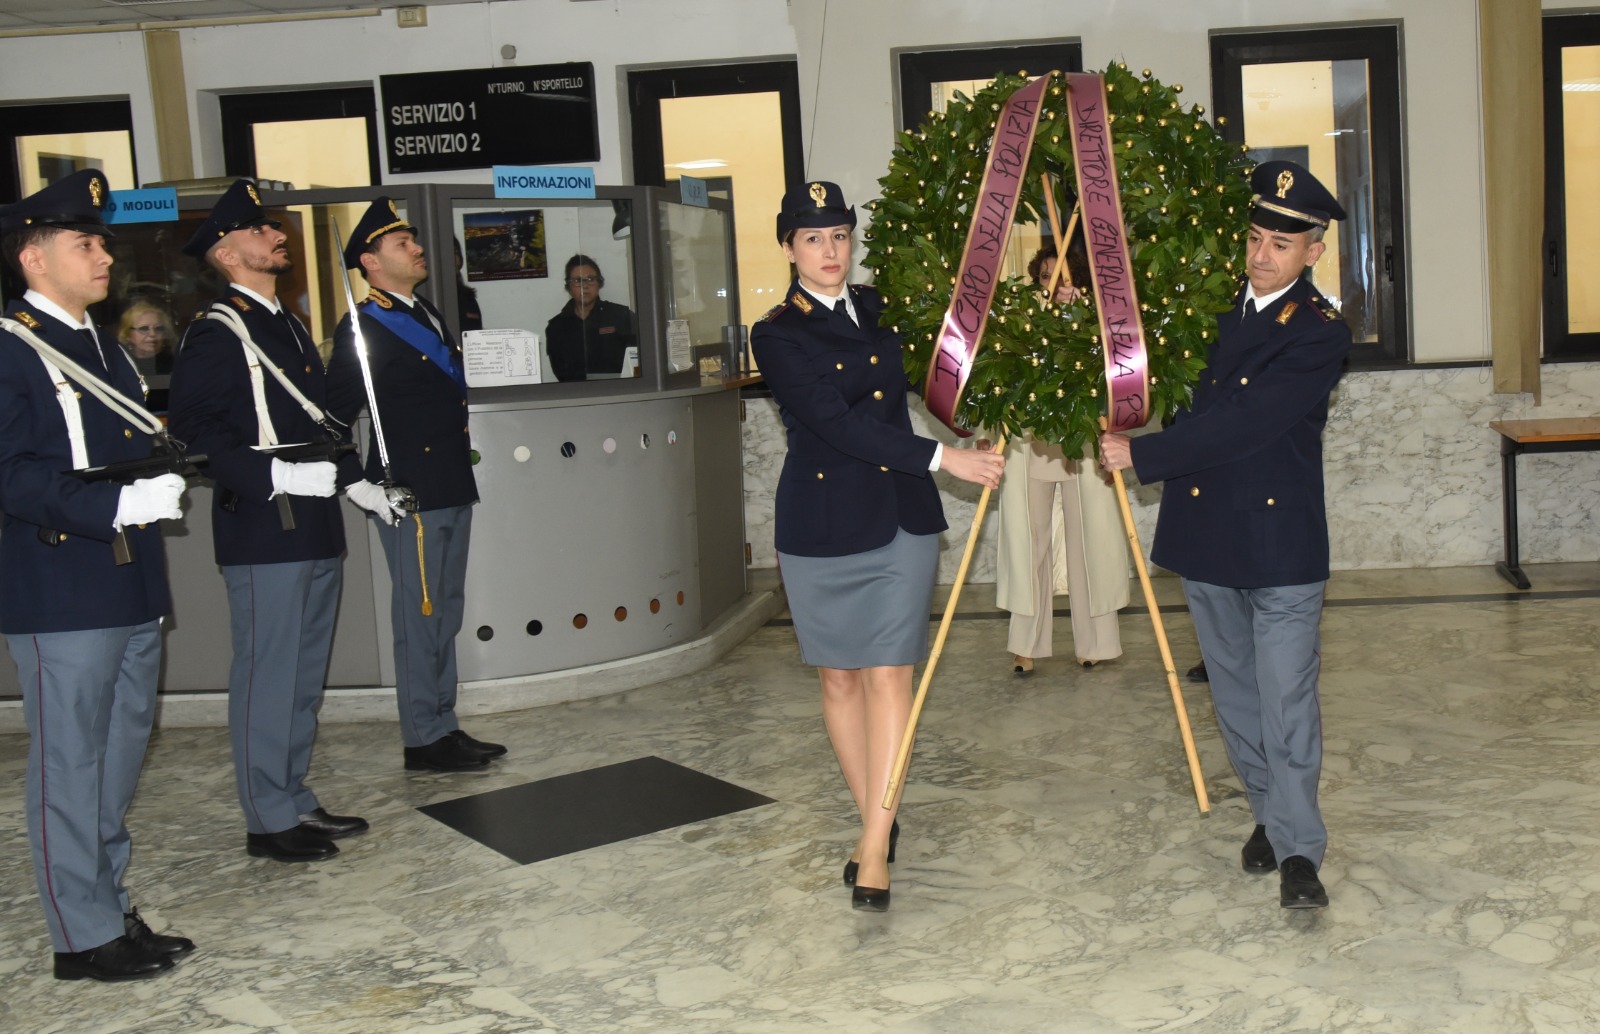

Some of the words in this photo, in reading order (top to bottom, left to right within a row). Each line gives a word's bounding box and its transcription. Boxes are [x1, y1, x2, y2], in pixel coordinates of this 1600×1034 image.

[391, 101, 465, 126] SERVIZIO
[468, 101, 477, 121] 1
[394, 133, 468, 156] SERVIZIO
[471, 132, 481, 152] 2
[992, 100, 1039, 179] POLIZIA
[497, 176, 592, 189] INFORMAZIONI
[1075, 101, 1112, 206] DIRETTORE
[123, 199, 175, 211] MODULI
[974, 191, 1013, 258] DELLA
[1090, 216, 1127, 308] GENERALE
[955, 264, 991, 333] CAPO
[1107, 316, 1135, 379] DELLA
[1115, 393, 1143, 427] PS
